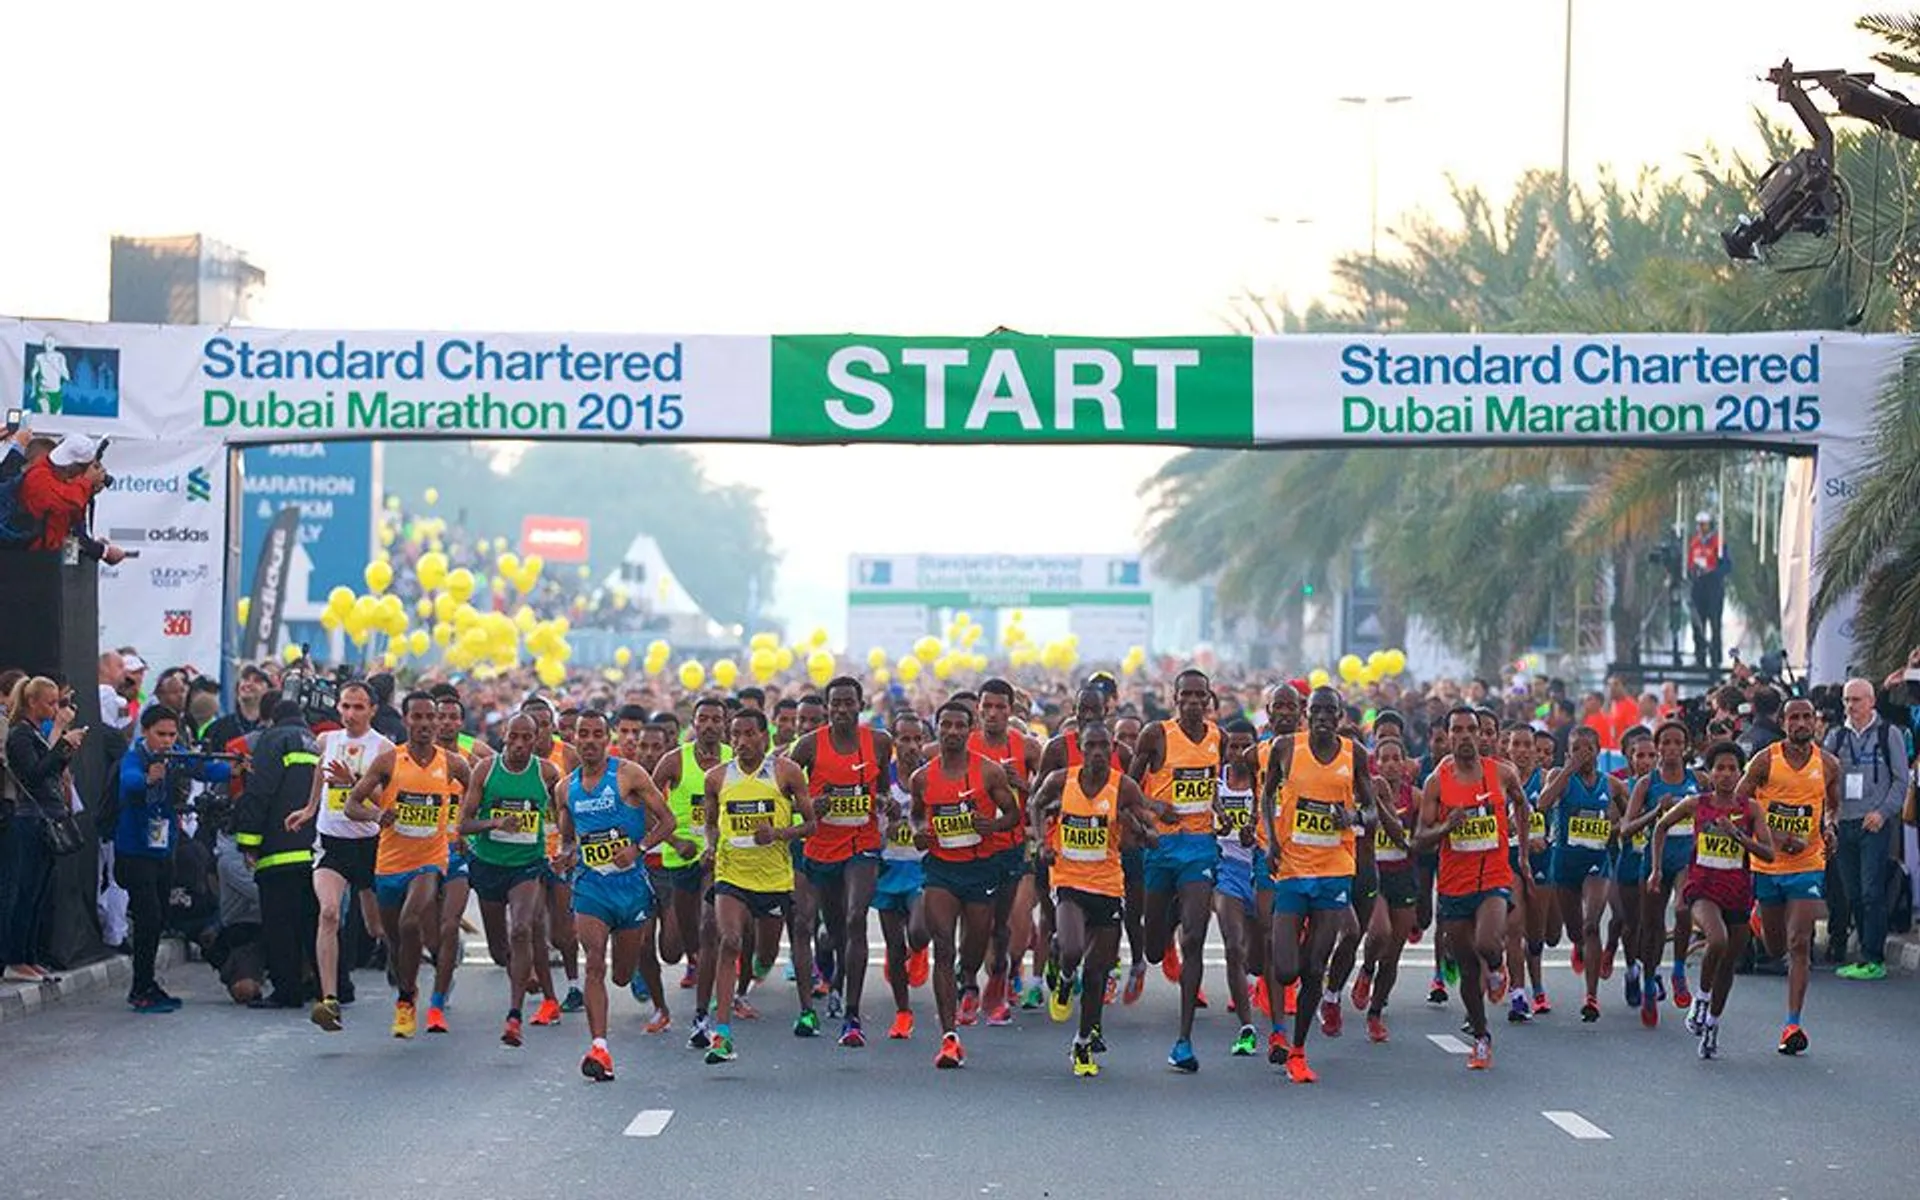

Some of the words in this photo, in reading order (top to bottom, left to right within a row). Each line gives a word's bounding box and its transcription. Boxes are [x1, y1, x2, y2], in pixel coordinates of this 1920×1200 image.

[203, 338, 425, 381] Standard
[437, 341, 683, 382] Chartered
[1341, 343, 1562, 386] Standard
[1573, 343, 1820, 385] Chartered
[824, 345, 1200, 431] START
[203, 391, 336, 429] Dubai
[346, 391, 566, 430] Marathon
[577, 393, 683, 430] 2015
[1342, 396, 1474, 434] Dubai
[1486, 396, 1706, 434] Marathon
[1715, 394, 1821, 433] 2015
[244, 475, 355, 495] MARATHON
[148, 528, 209, 542] adidas
[259, 529, 286, 640] adidas
[163, 616, 191, 635] 360
[1175, 781, 1212, 800] PACE
[1296, 811, 1331, 831] PAC
[1768, 814, 1809, 833] BAYISA
[1063, 826, 1106, 846] TARUS
